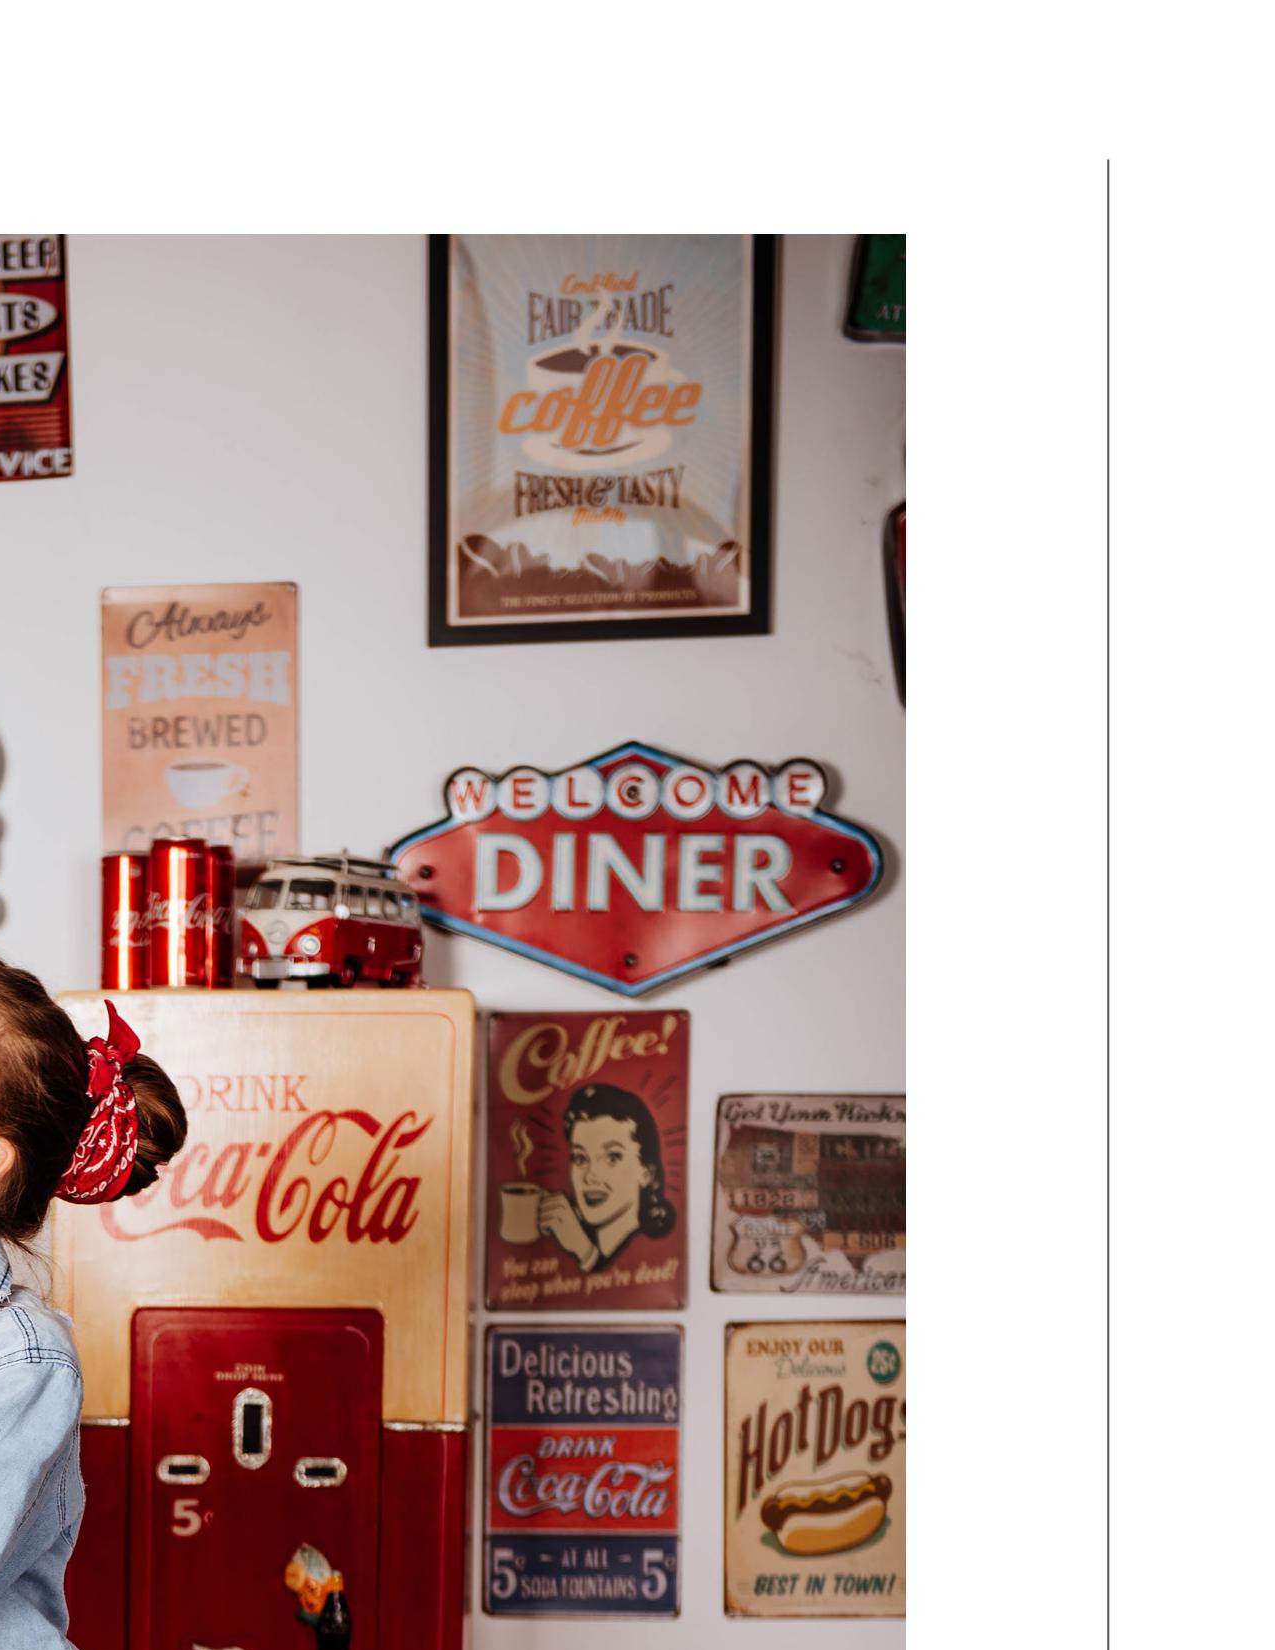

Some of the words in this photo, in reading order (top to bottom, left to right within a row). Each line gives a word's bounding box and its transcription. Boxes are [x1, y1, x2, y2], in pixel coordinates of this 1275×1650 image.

[529, 291, 582, 344] FAIR
[498, 355, 702, 449] coffee
[515, 471, 582, 517] FRESH
[618, 464, 685, 509] TASTY
[127, 601, 273, 648] Always
[107, 650, 290, 711] FRESH
[128, 714, 267, 750] BREWED
[452, 771, 814, 813] WELCOME
[476, 831, 797, 913] DINER
[499, 1015, 677, 1105] Coffee!
[746, 1251, 787, 1274] 66
[501, 1339, 633, 1379] Delicious
[746, 1339, 803, 1357] ENJOY
[808, 1338, 845, 1357] OUR
[527, 1379, 677, 1421] Refreshing
[538, 1436, 617, 1458] DRINK
[561, 1548, 578, 1568] AT
[584, 1548, 608, 1569] ALL
[521, 1575, 557, 1598] SODA
[561, 1575, 637, 1598] FOUNTAINS
[754, 1573, 798, 1597] BEST
[805, 1574, 826, 1597] IN
[834, 1573, 896, 1597] TOWN!
